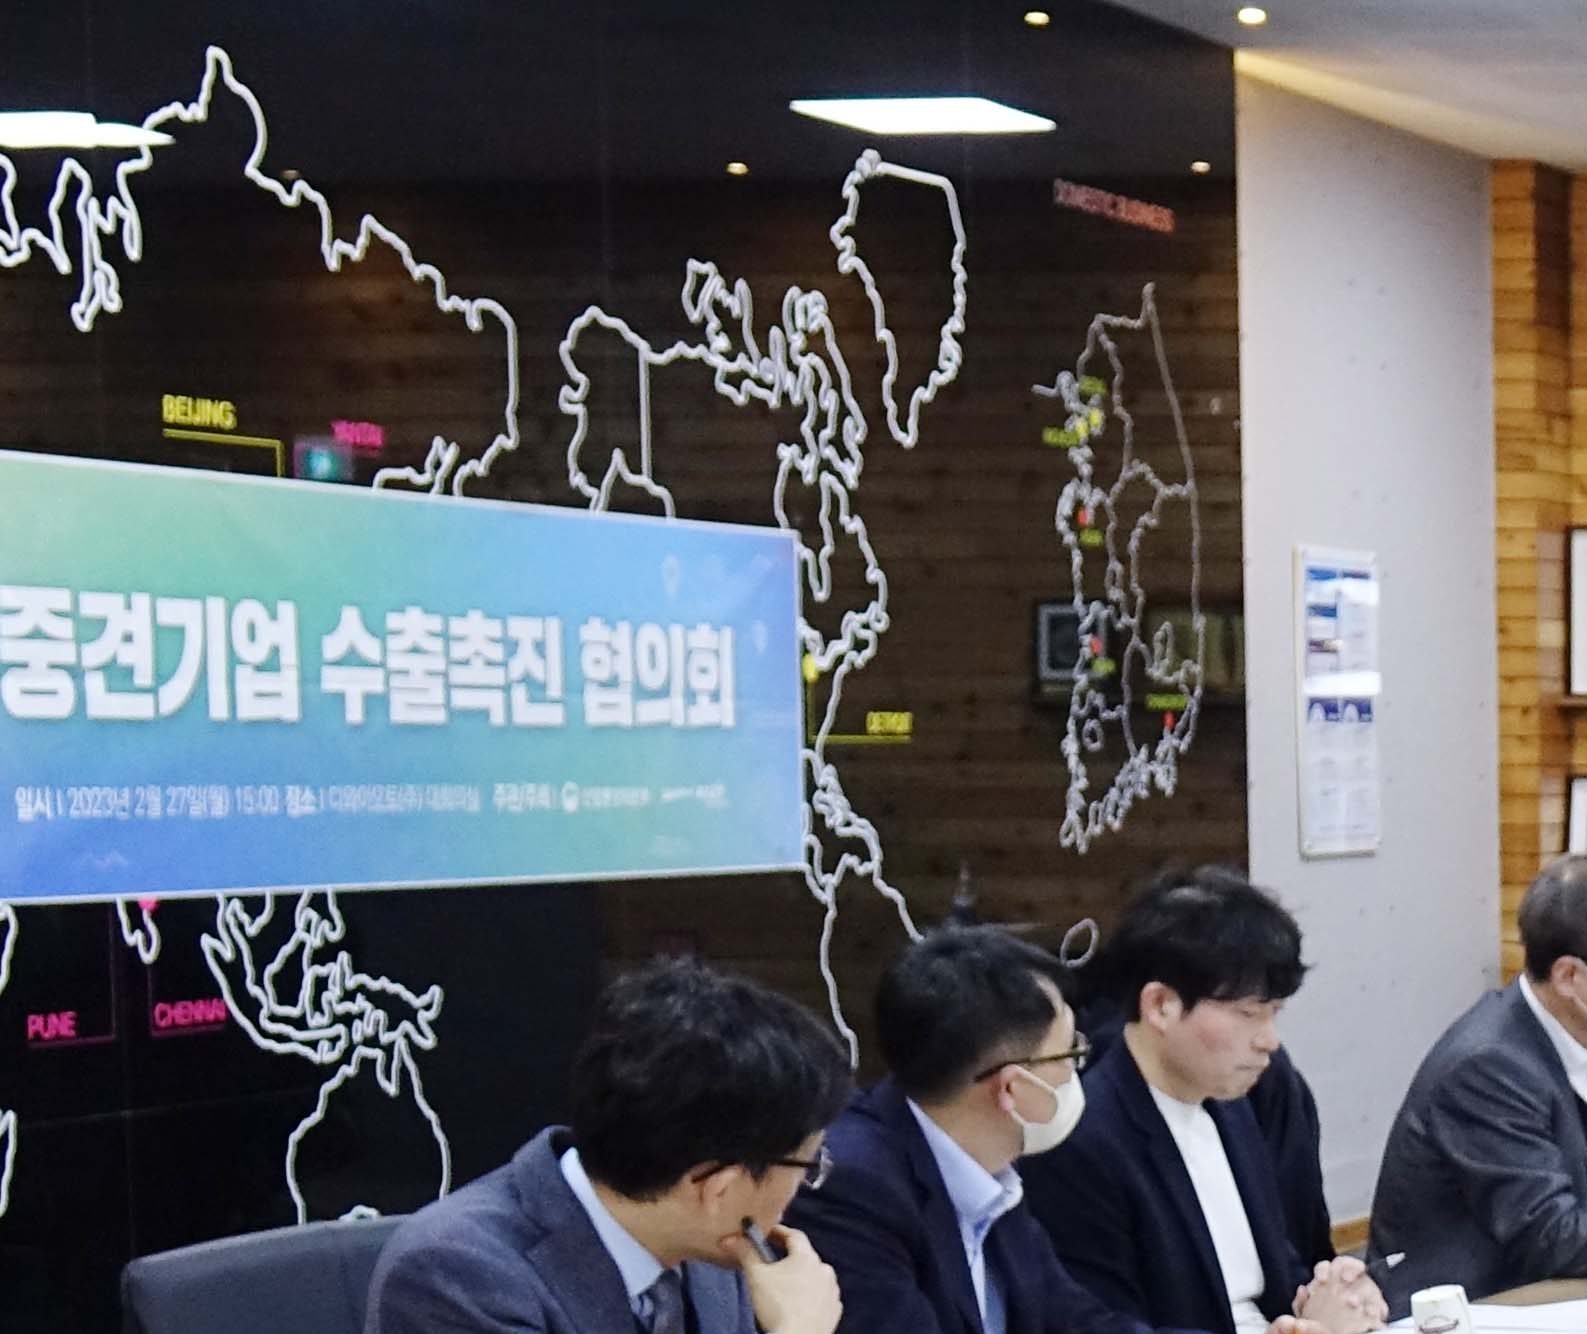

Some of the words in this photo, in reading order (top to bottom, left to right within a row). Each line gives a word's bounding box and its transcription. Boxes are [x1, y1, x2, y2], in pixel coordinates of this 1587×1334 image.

[162, 394, 238, 430] BEIJING
[0, 584, 302, 723] 중견기업
[320, 604, 567, 727] 수출촉진
[579, 606, 737, 728] 협의회
[15, 785, 54, 823] 일시
[66, 785, 131, 820] 2023년
[134, 785, 162, 819] 2월
[285, 784, 316, 818] 장소
[27, 1011, 77, 1041] PUNE
